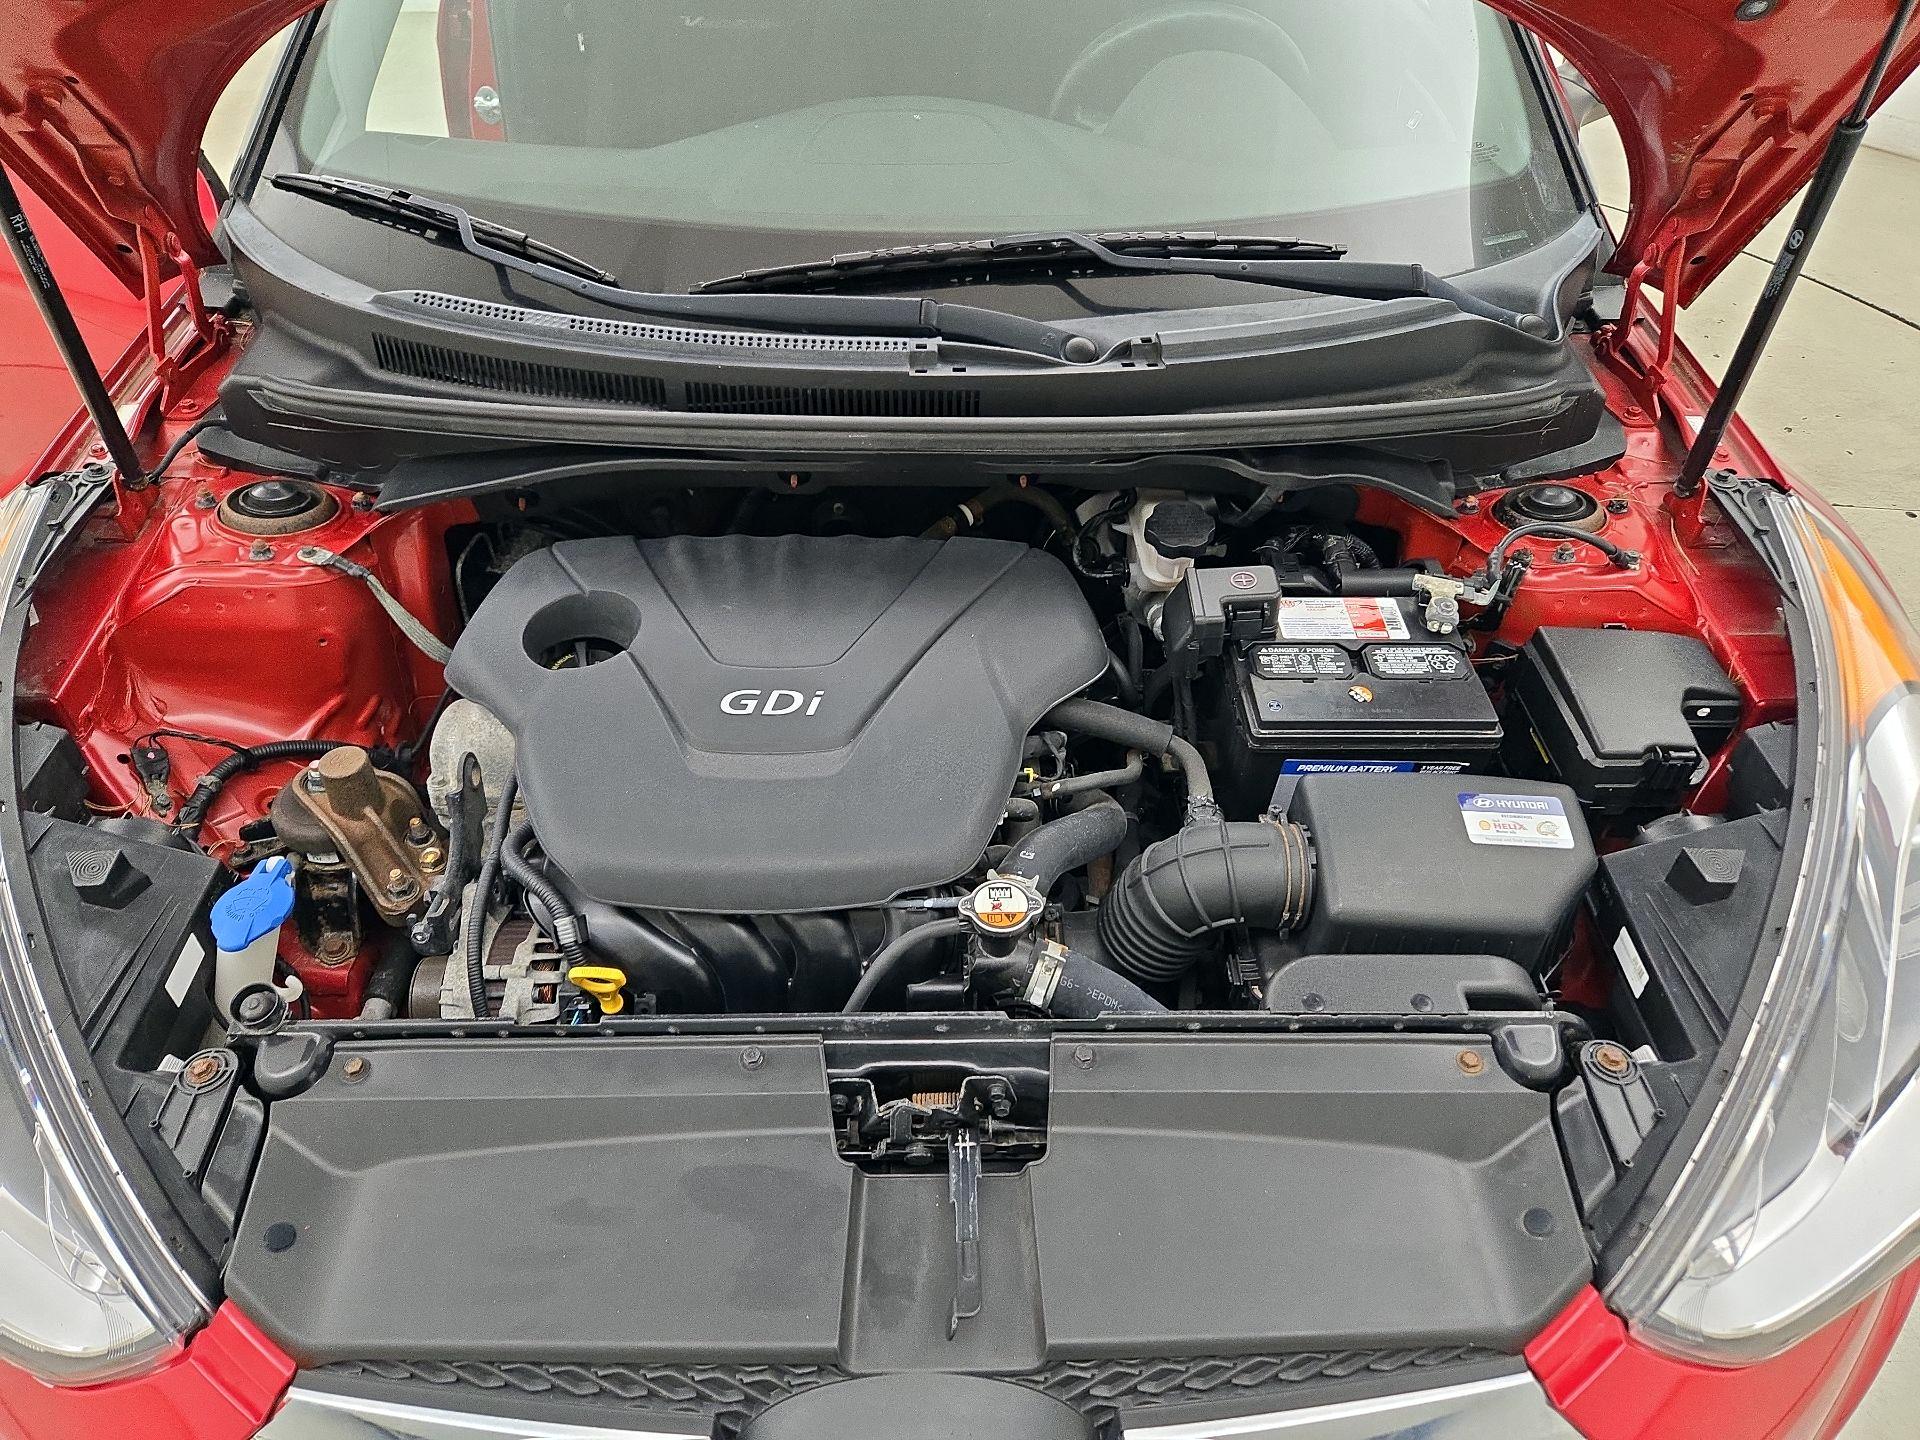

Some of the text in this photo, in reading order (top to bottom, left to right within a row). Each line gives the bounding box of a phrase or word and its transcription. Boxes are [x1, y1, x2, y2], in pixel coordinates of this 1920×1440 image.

[10, 213, 27, 233] RH
[720, 690, 825, 716] GDi
[1296, 764, 1398, 773] PREMIUM BATTERY
[1496, 800, 1549, 810] HYUNDAI
[1493, 822, 1528, 831] HELIX
